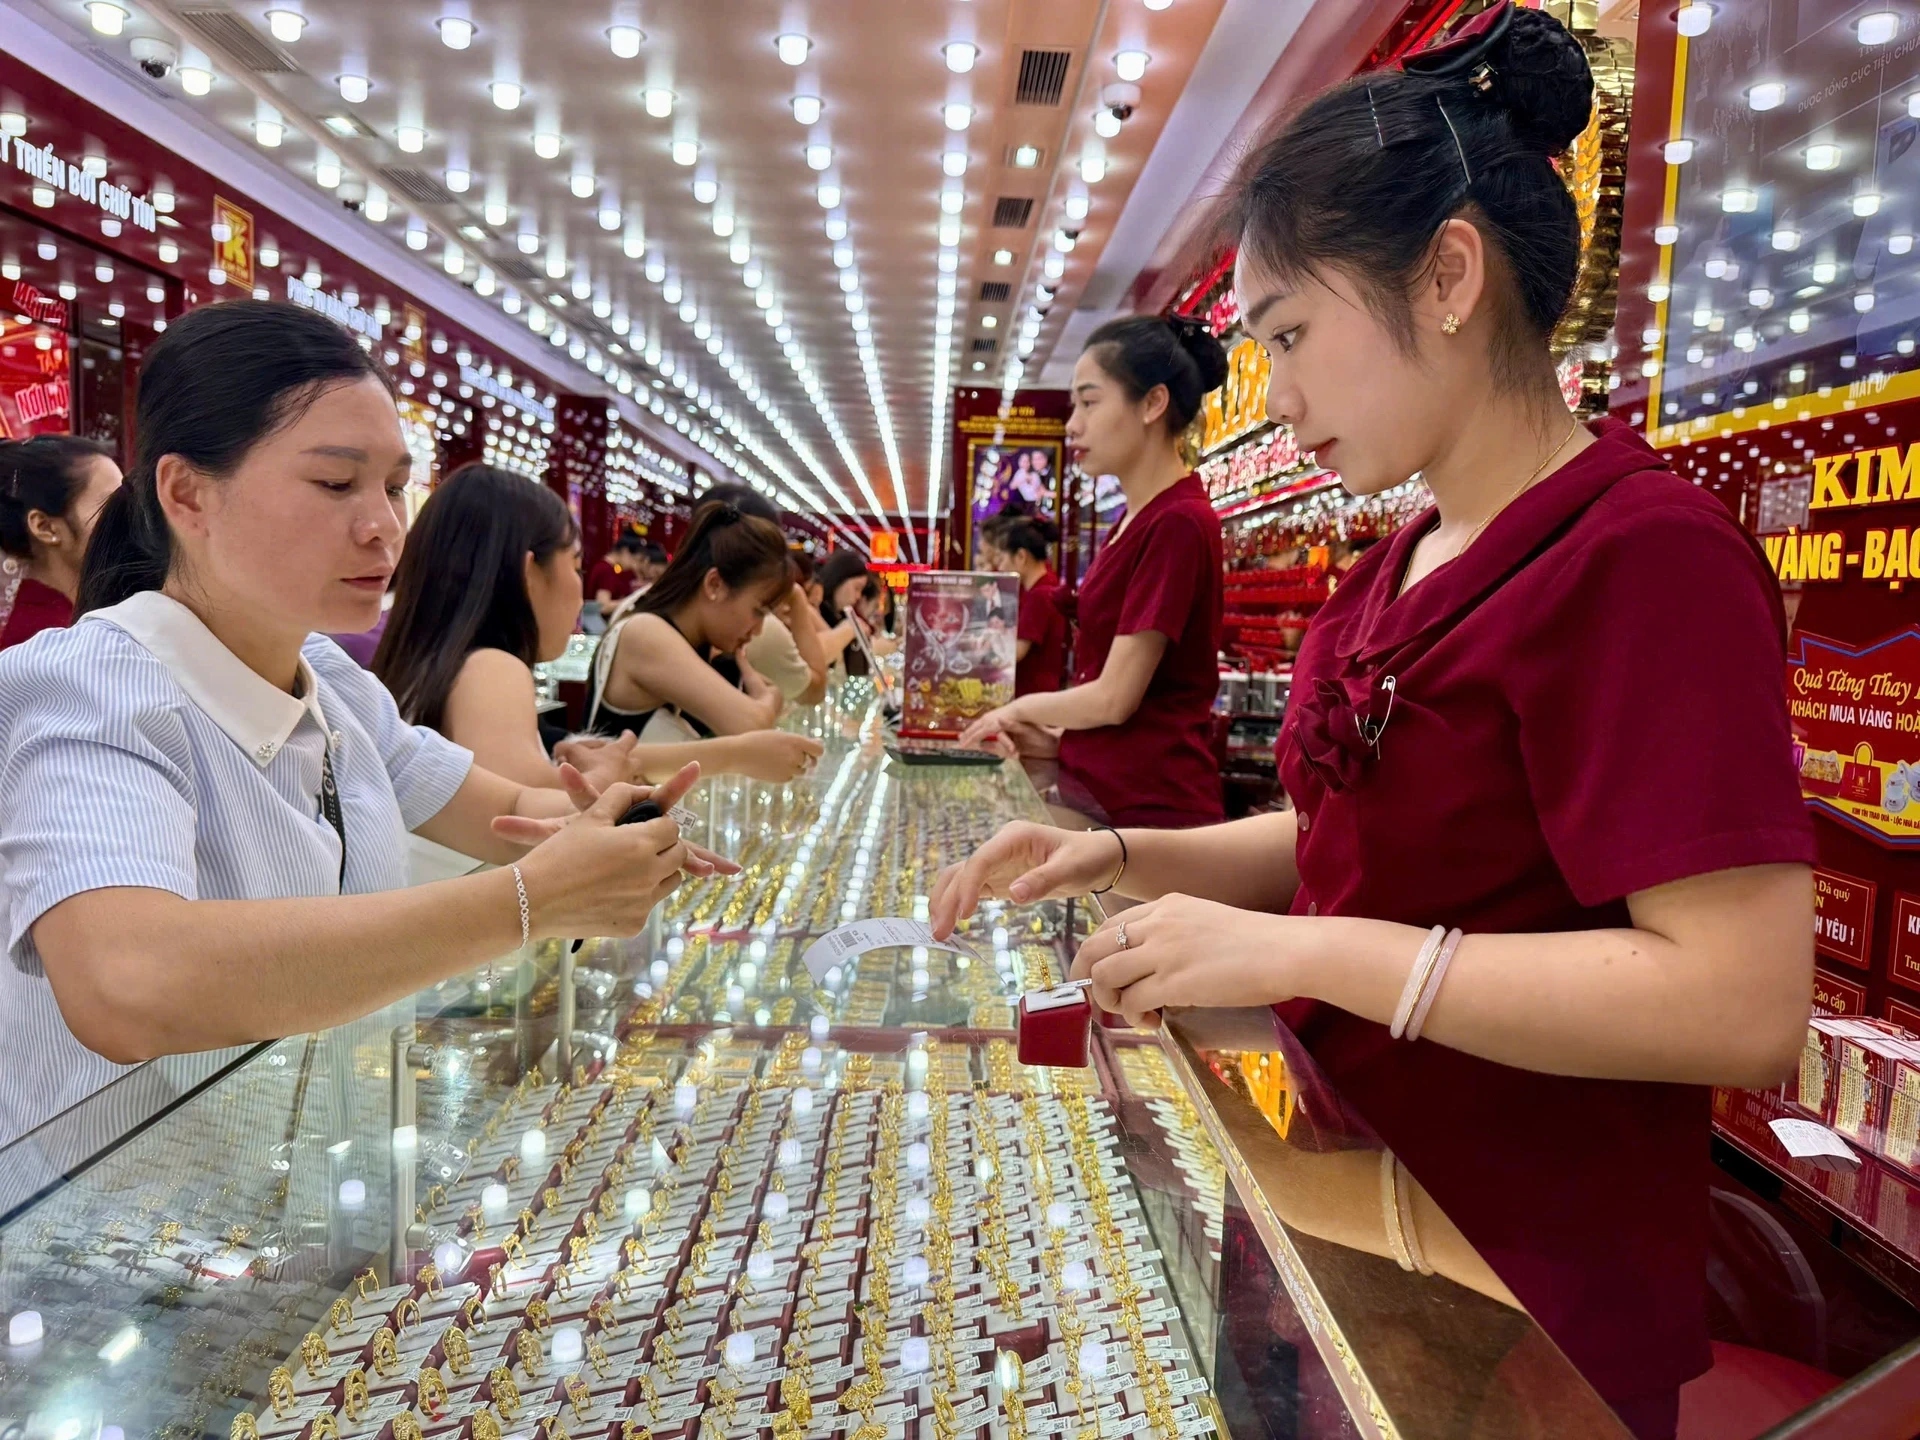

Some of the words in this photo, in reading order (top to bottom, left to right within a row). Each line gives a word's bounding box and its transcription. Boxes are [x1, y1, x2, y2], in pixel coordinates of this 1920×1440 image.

[14, 143, 66, 190] TRIỂN
[99, 180, 132, 220] CHỮ
[1808, 442, 1920, 510] KIM
[1794, 667, 1823, 695] Quà
[1827, 669, 1866, 701] Tặng
[1869, 672, 1912, 706] Thay
[1791, 697, 1827, 720] KHÁCH
[1829, 704, 1855, 724] MUA
[1859, 704, 1893, 729] VÀNG
[1818, 879, 1832, 895] Đá
[1833, 887, 1850, 902] quý
[1826, 917, 1847, 943] YÊU
[1849, 927, 1855, 946] !
[1813, 983, 1828, 1004] Cao
[1830, 992, 1846, 1014] cấp
